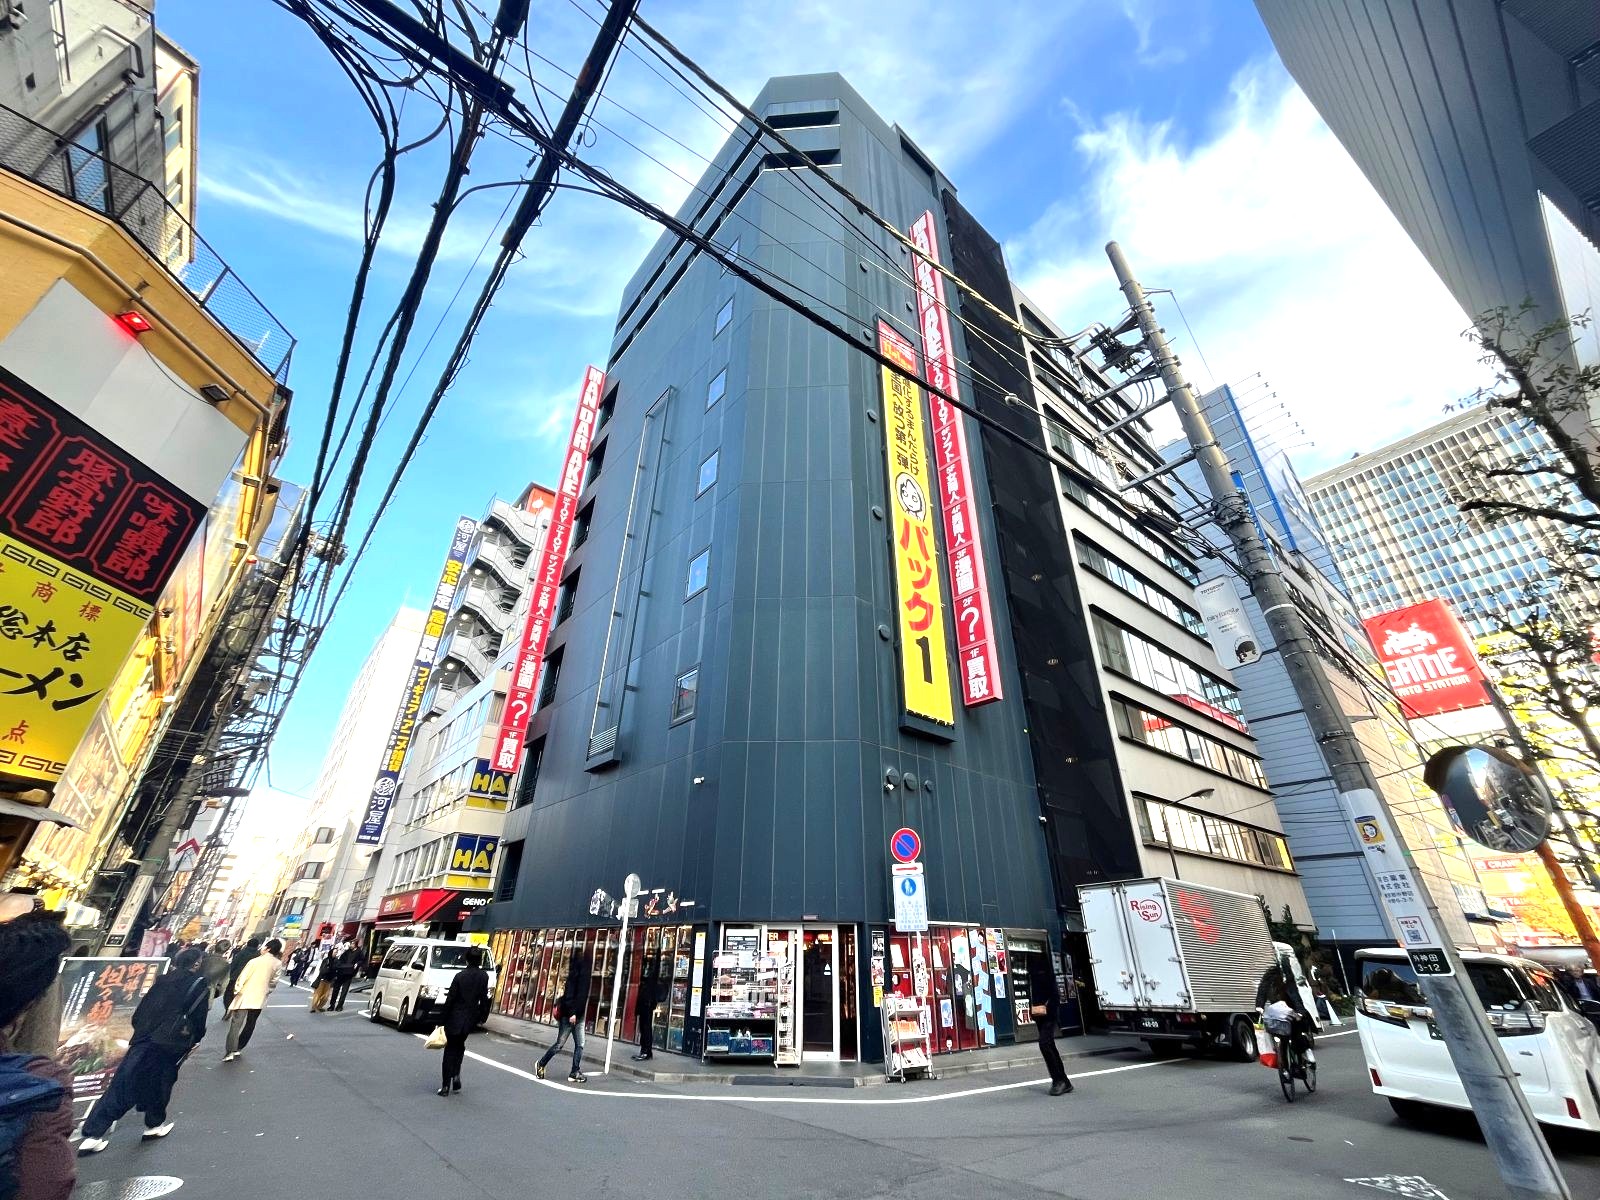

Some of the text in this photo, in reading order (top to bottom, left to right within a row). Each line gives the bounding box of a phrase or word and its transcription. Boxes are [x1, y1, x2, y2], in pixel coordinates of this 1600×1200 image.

[562, 367, 603, 497] MANDARAKE
[942, 433, 954, 463] ソフト
[559, 501, 570, 523] TOY
[102, 490, 180, 582] 味噌野郎
[553, 529, 565, 552] TOY
[545, 560, 558, 583] ソフト
[955, 556, 975, 595] 漫画
[960, 607, 979, 642] ?
[516, 660, 537, 690] 漫画
[966, 655, 989, 699] 買取
[1382, 647, 1465, 687] GAME
[511, 700, 528, 727] ?
[497, 737, 519, 770] 買取
[1130, 901, 1157, 911] Rising
[1142, 910, 1159, 921] Sun
[1412, 953, 1439, 963] 外神田
[1418, 963, 1441, 972] 3-12
